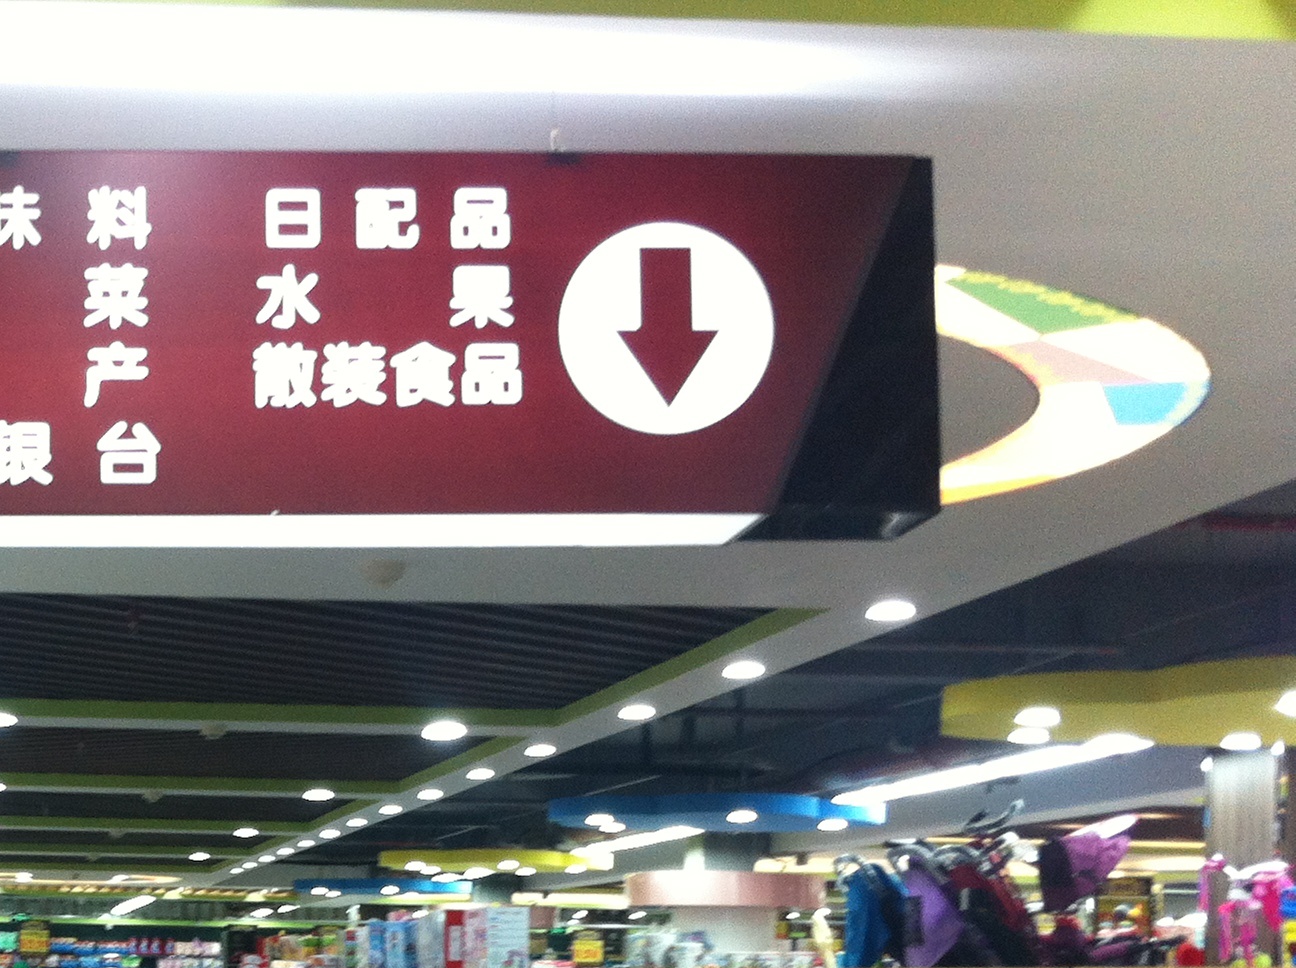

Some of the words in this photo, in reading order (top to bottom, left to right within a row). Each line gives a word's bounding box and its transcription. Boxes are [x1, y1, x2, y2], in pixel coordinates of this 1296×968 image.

[265, 187, 511, 249] 日配品
[253, 341, 522, 408] 散装食品
